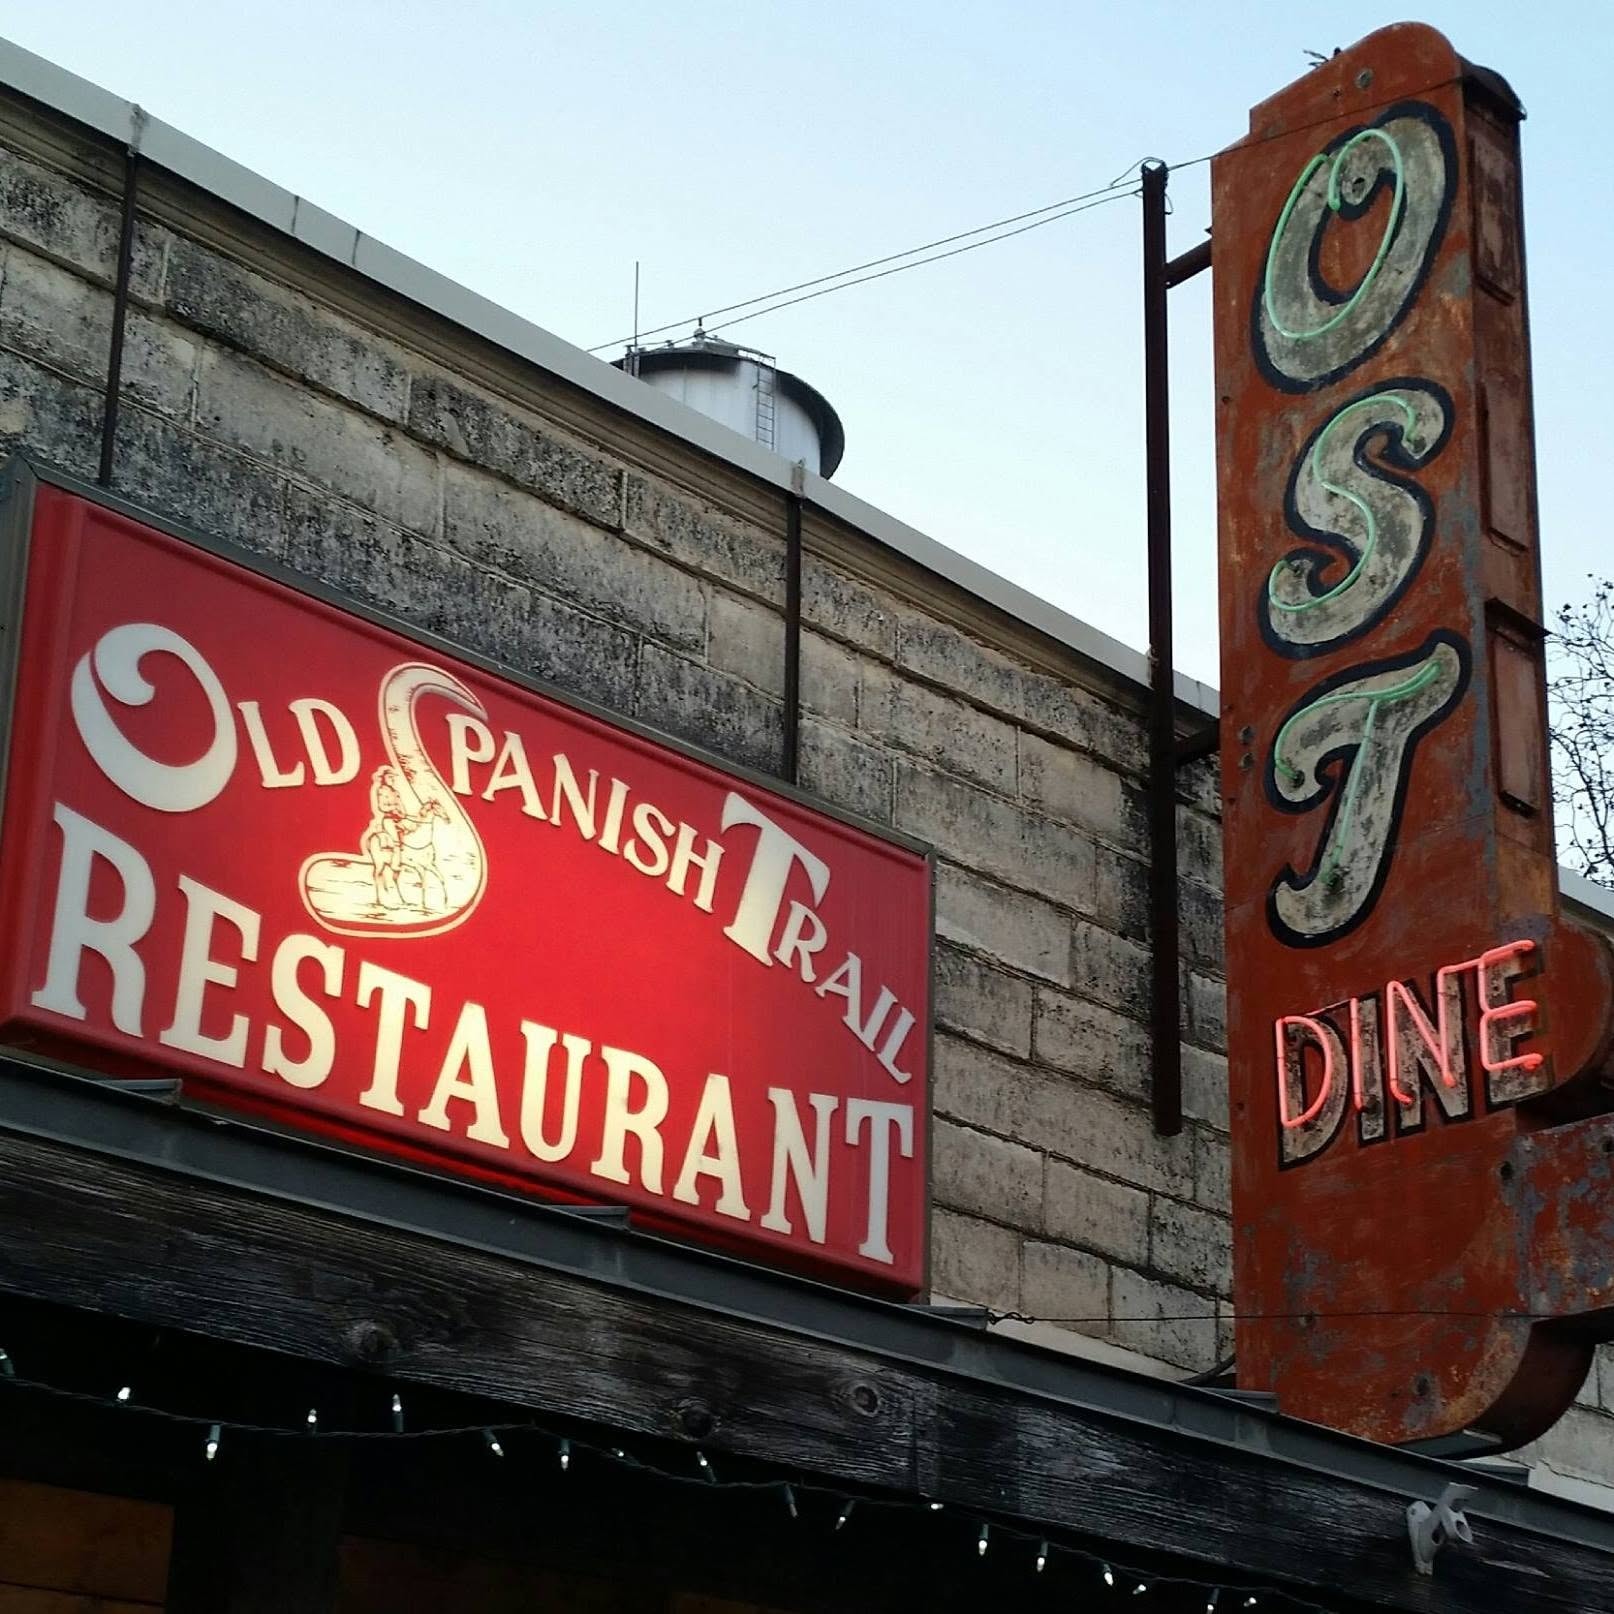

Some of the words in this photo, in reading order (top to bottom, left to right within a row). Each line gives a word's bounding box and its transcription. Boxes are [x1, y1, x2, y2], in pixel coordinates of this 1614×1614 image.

[1252, 101, 1470, 947] OST
[31, 801, 915, 1265] RESTAURANT
[71, 622, 361, 813] OLD
[298, 661, 726, 939] SPANISH
[721, 791, 917, 1085] TRAIL
[1274, 939, 1548, 1170] DINE
